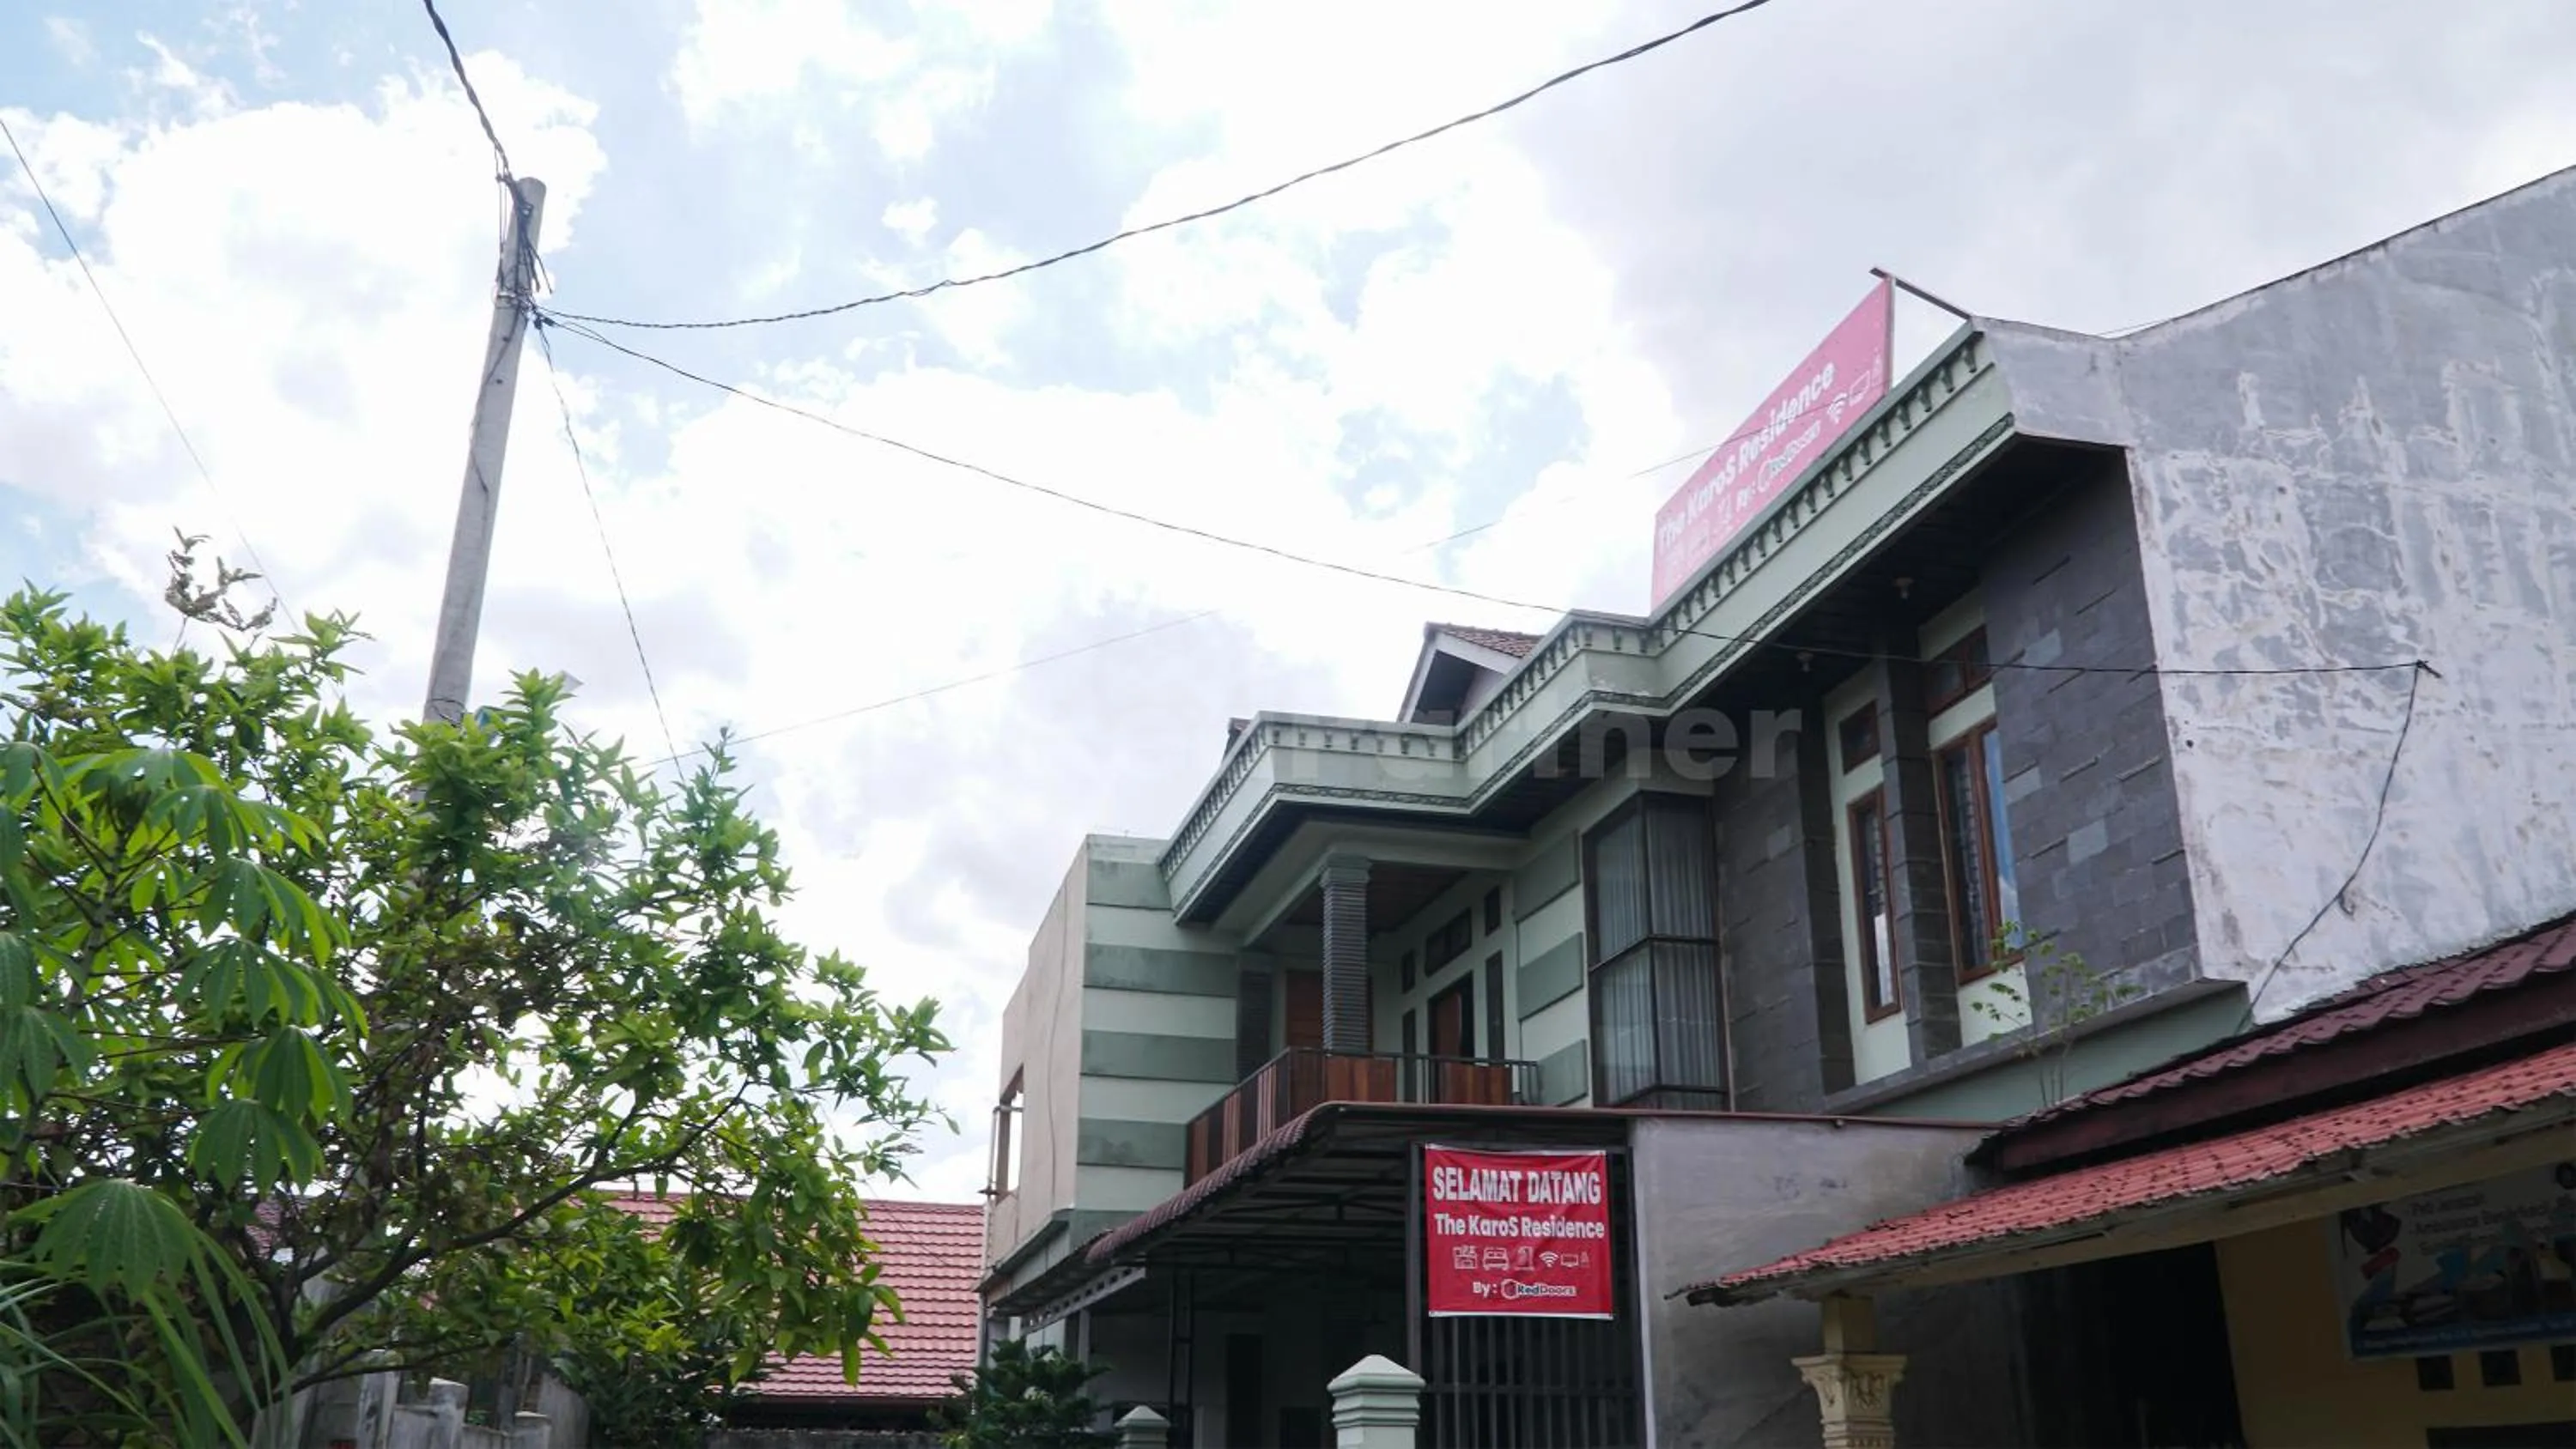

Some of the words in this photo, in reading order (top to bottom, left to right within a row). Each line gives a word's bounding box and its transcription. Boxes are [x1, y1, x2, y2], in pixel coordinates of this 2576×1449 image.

[1658, 509, 1686, 555] The
[1738, 361, 1836, 476] Residence
[1432, 1166, 1522, 1203] SELAMAT
[1528, 1170, 1601, 1205] DATANG
[1434, 1213, 1466, 1235] The
[1468, 1215, 1519, 1237] KaroS
[1521, 1214, 1605, 1239] Residence
